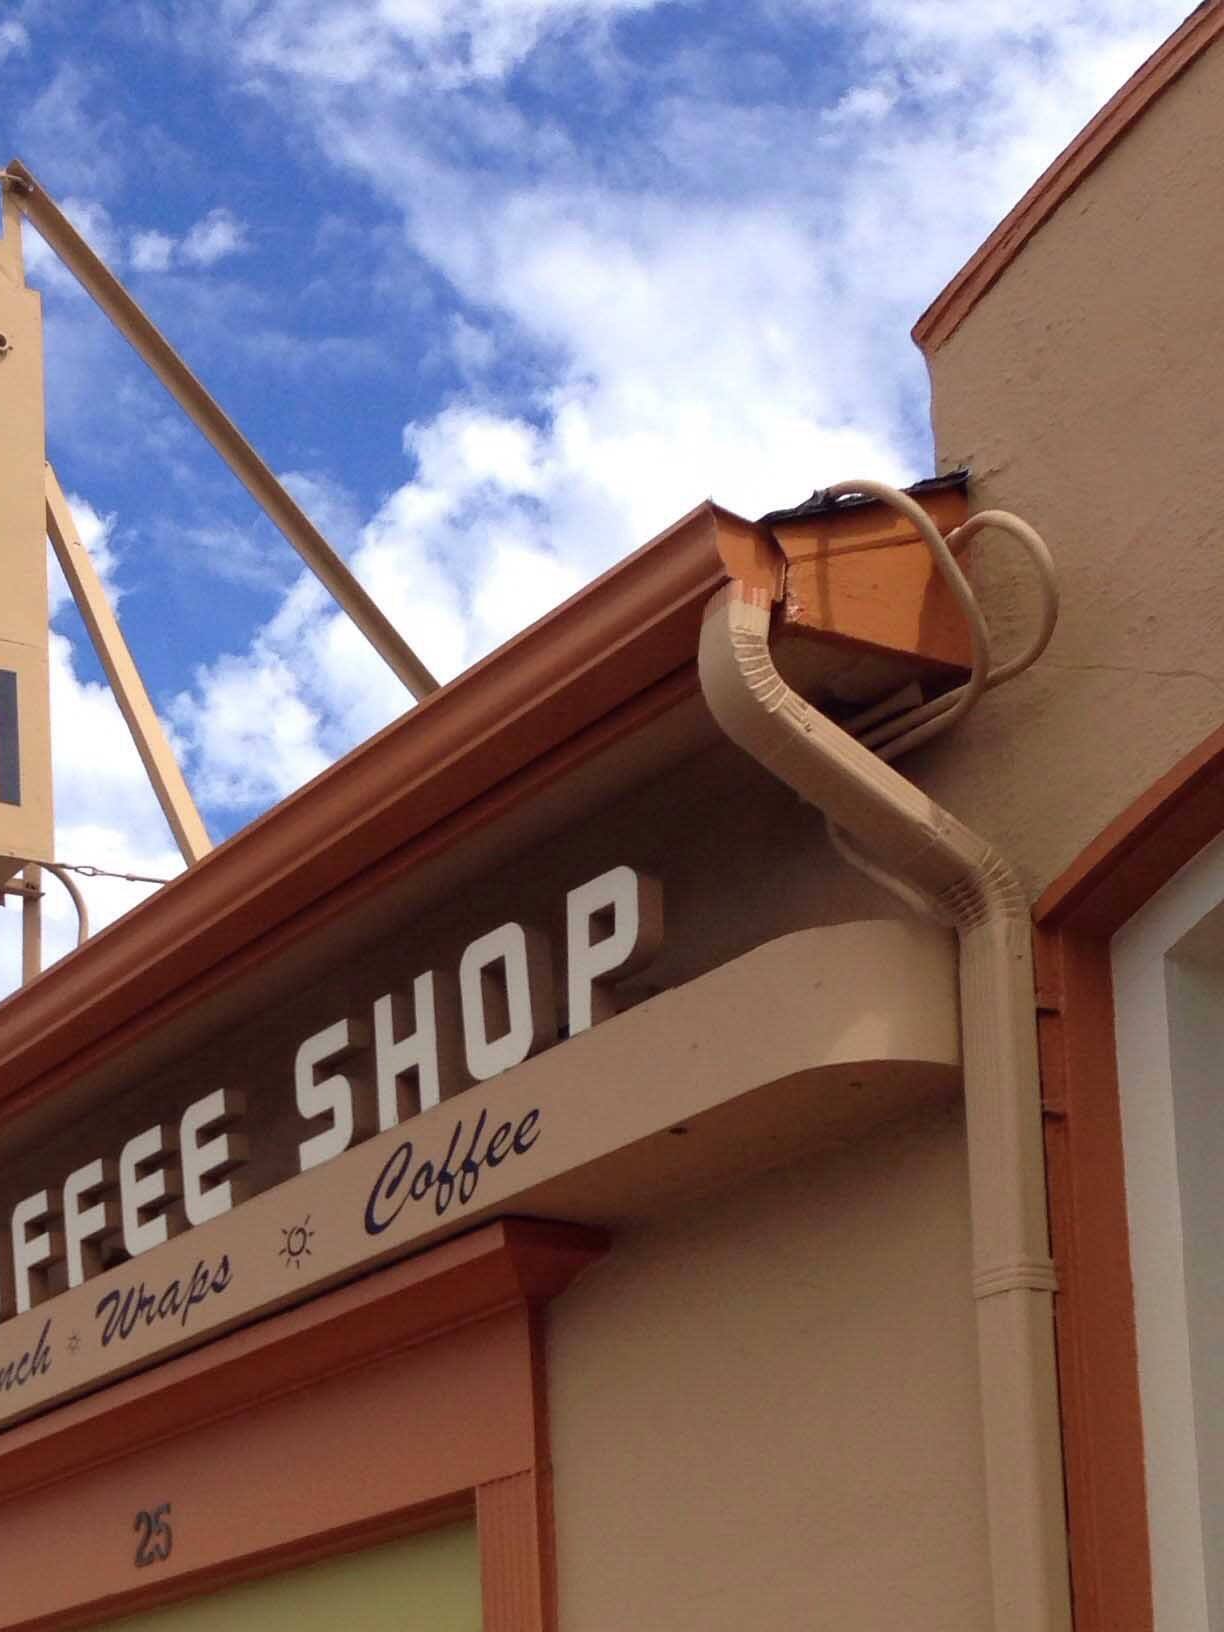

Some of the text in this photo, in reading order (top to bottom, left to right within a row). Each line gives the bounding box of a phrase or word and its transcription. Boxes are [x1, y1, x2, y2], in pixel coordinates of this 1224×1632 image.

[294, 865, 639, 1172] SHOP
[95, 1254, 233, 1347] Wraps
[364, 1108, 541, 1236] Coffee
[133, 1503, 173, 1568] 25
